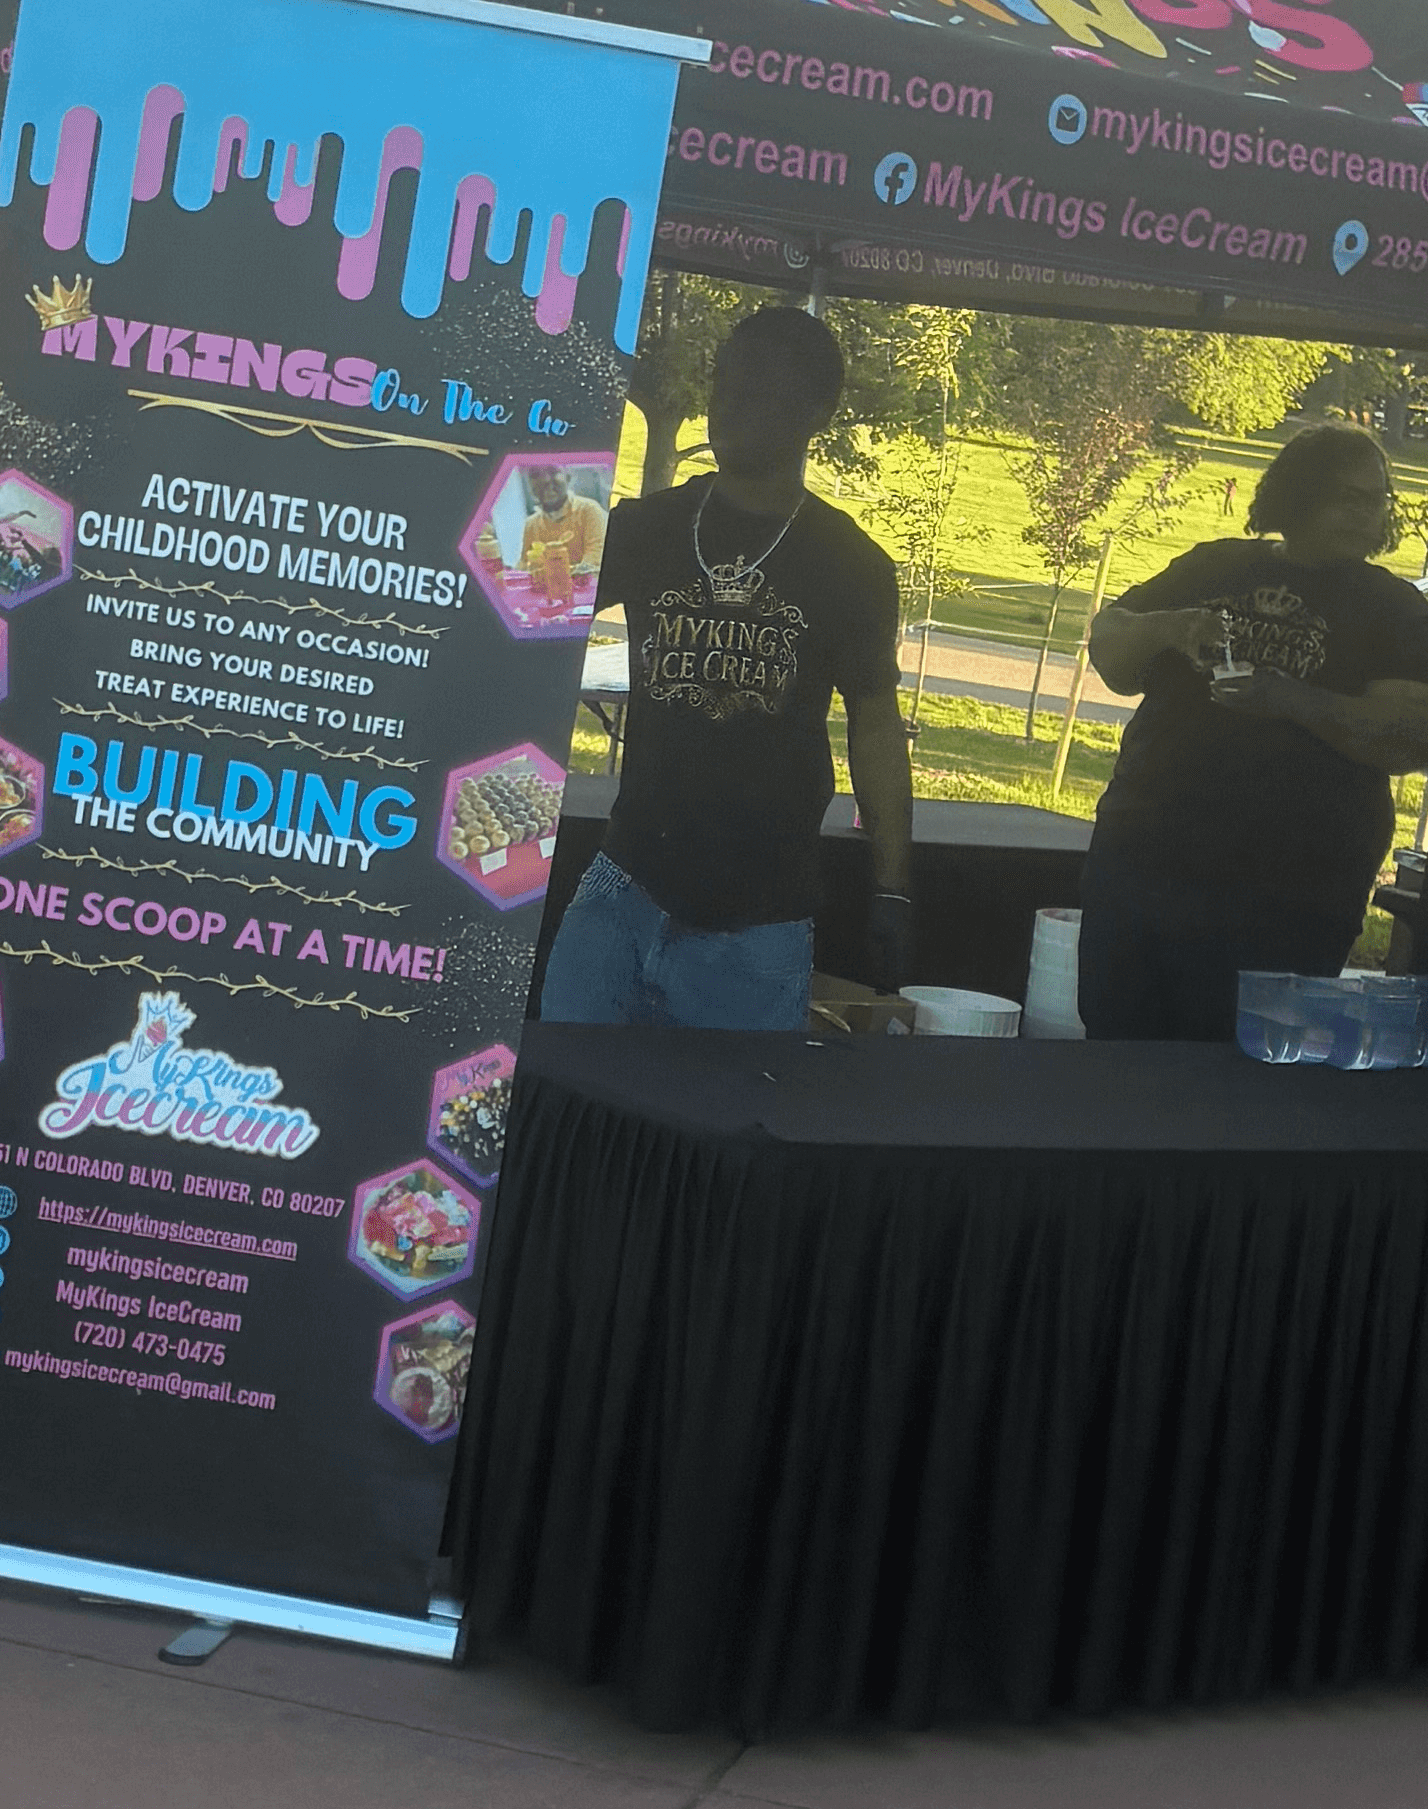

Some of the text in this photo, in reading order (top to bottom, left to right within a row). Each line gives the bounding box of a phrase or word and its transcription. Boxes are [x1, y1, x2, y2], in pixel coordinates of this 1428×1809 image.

[923, 161, 1308, 265] MyKings IceCream
[41, 314, 377, 407] MYKINGS
[371, 368, 429, 412] On
[440, 378, 514, 424] The
[141, 473, 409, 551] ACTIVATE YOUR
[77, 511, 468, 609] CHILDHOOD MEMORIES!
[86, 594, 430, 668] INVITE US TO ANY OCCASION!
[129, 638, 375, 697] BRING YOUR DESIRED
[95, 670, 405, 740] TREAT EXPERIENCE TO LIFE!
[52, 732, 418, 850] BUILDING
[72, 794, 380, 872] THE COMMUNITY
[77, 893, 227, 945] SCOOP
[233, 920, 292, 957] AT
[296, 929, 330, 965] A
[342, 933, 447, 984] TIME!
[16, 1146, 29, 1167] N
[33, 1150, 124, 1183] COLORADO
[261, 1187, 285, 1209] CO
[289, 1191, 346, 1219] 80207
[38, 1196, 298, 1260] https://mykingsicecream.com
[56, 1278, 242, 1333] MyKings IceCream
[67, 1245, 249, 1294] mykingsicecream
[4, 1346, 276, 1410] mykingsicecream@gmail.com
[74, 1320, 226, 1367] (720) 473-0475
